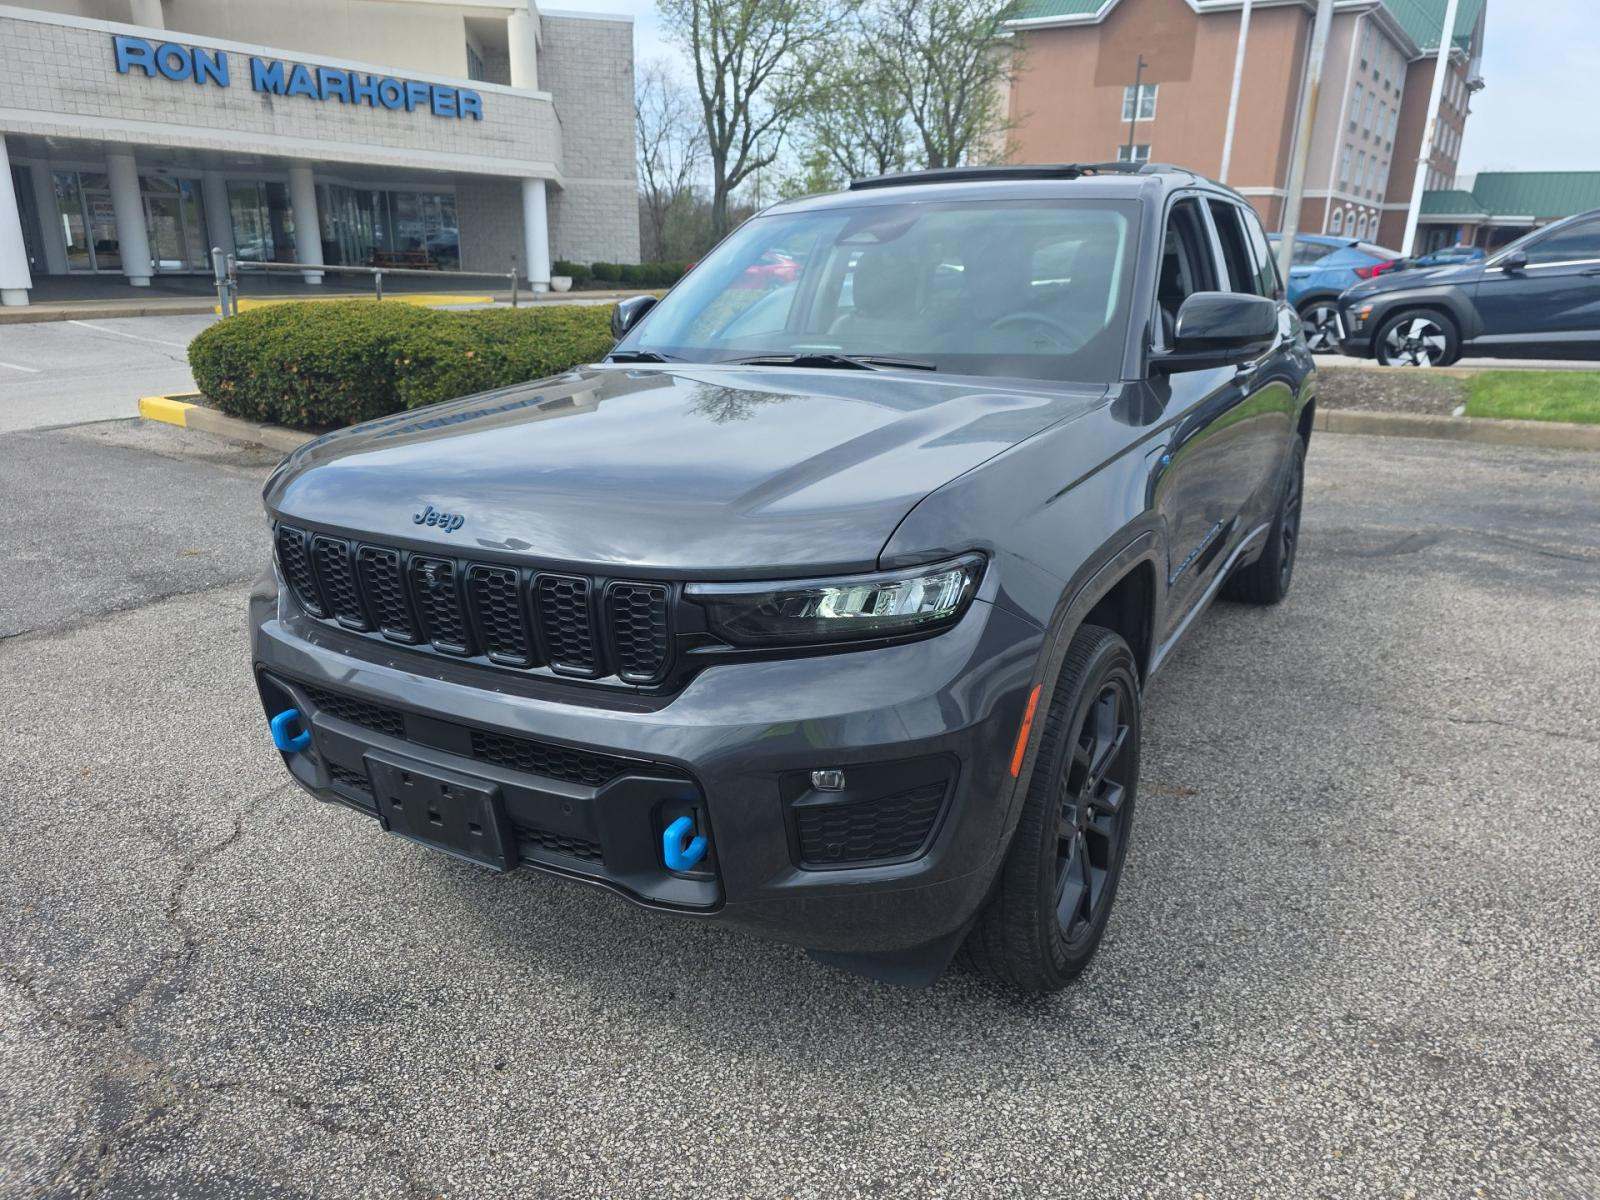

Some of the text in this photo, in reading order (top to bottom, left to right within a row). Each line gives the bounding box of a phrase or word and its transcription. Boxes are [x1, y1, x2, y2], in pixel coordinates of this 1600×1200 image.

[112, 35, 483, 121] RON MARHOFER
[412, 505, 465, 534] Jeep
